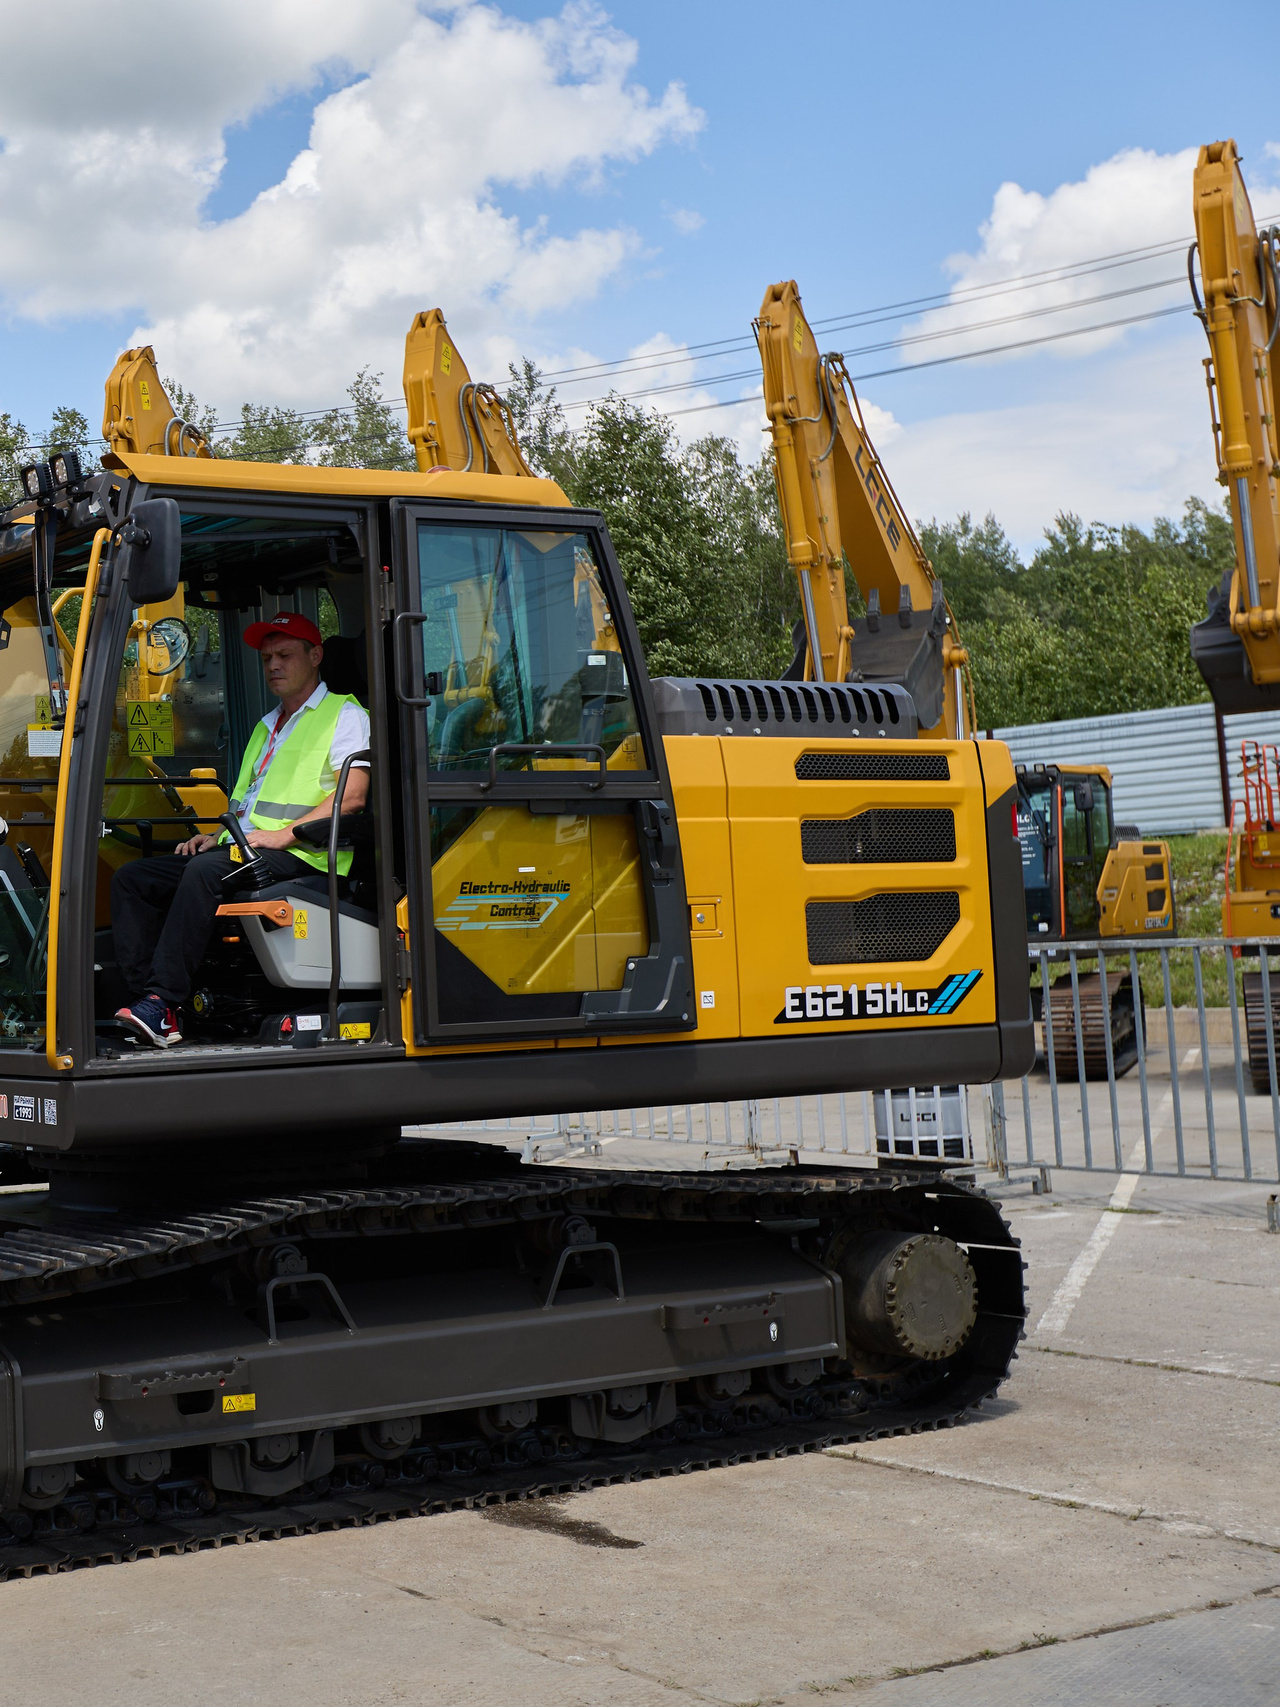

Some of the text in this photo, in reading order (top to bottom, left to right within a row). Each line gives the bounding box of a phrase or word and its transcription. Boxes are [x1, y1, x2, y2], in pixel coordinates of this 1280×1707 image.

[854, 443, 902, 553] LGCE
[459, 880, 571, 895] Electro-Hydraulic
[489, 903, 537, 917] Control
[785, 981, 930, 1019] E6215HLC
